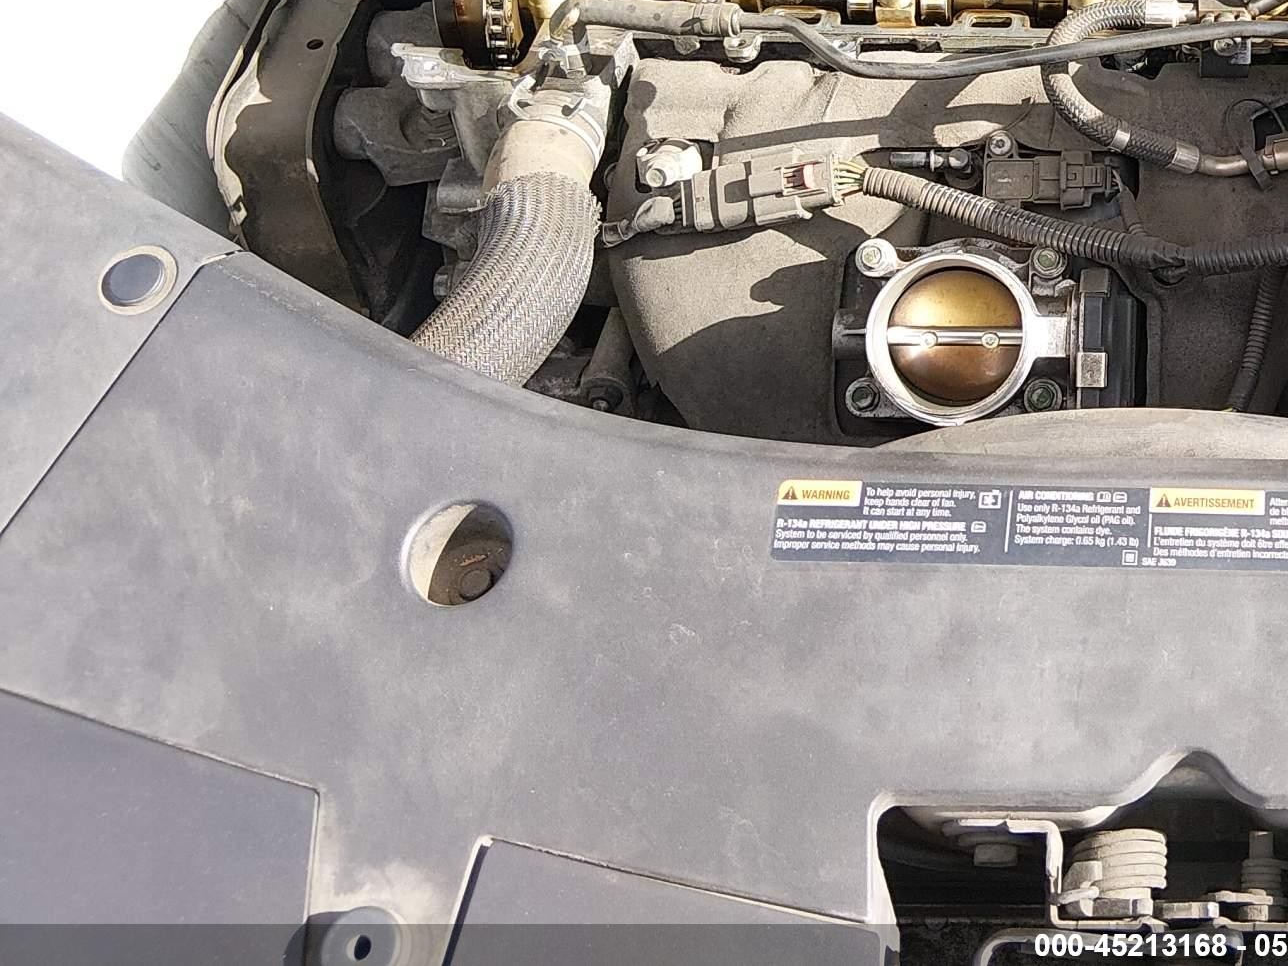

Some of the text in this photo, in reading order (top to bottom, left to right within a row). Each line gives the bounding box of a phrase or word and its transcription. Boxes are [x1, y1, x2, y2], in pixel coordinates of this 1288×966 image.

[802, 490, 850, 500] WARNING
[866, 487, 876, 496] To
[877, 488, 894, 498] help
[895, 488, 917, 497] avoid
[918, 489, 950, 500] personal
[1018, 490, 1094, 500] AIR CONDITIONING
[864, 498, 956, 508] keep hands clear of fan.
[1174, 498, 1254, 508] AVERTISSEMENT
[863, 508, 869, 516] It
[886, 508, 905, 516] start
[916, 509, 932, 518] any
[932, 508, 951, 517] time.
[1018, 504, 1140, 515] Use only R-134a Refrigerant and
[1270, 508, 1280, 516] de
[776, 518, 966, 532] R-134a REFRIGERANT UNDER HIGH PRESSURE
[1016, 514, 1136, 526] Polyalkylene Glycol oil (PAG oil).
[776, 528, 967, 543] System to be serviced by qualified personnel only.
[1016, 524, 1112, 536] The system contains dye.
[1154, 526, 1184, 536] FLUIDE
[1240, 528, 1270, 538] R-134a
[1014, 534, 1139, 548] System charge: 0.65 kg (1.43 lb)
[1154, 537, 1194, 546] L'entretien
[1196, 538, 1206, 547] du
[1207, 538, 1239, 549] système
[1241, 540, 1256, 548] doit
[1258, 539, 1272, 548] être
[774, 540, 980, 554] Improper service methods may cause personal injury.
[1153, 547, 1169, 556] Des
[1170, 547, 1208, 557] méthodes
[1210, 548, 1251, 558] d'entretien
[1142, 557, 1157, 566] SAE
